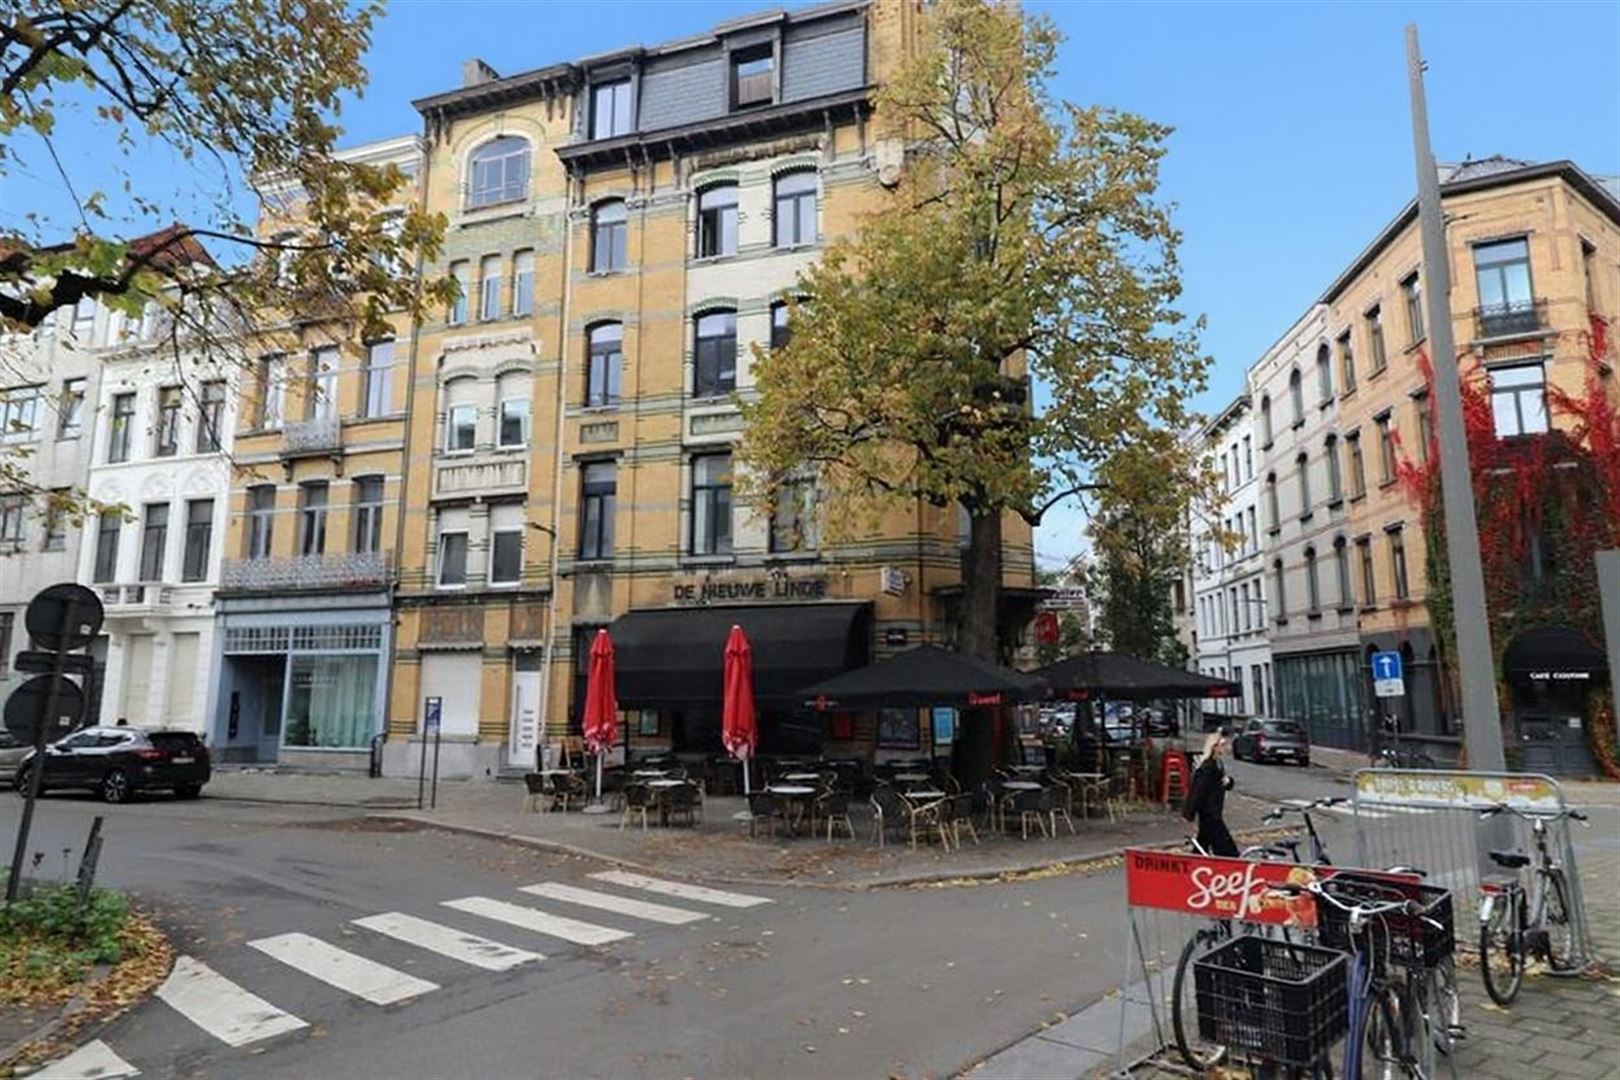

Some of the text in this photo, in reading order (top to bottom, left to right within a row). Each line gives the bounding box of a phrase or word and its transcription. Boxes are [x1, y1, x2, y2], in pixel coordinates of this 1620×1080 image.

[674, 584, 695, 599] DE
[1134, 854, 1189, 875] DRINKT
[1187, 863, 1265, 918] Seef
